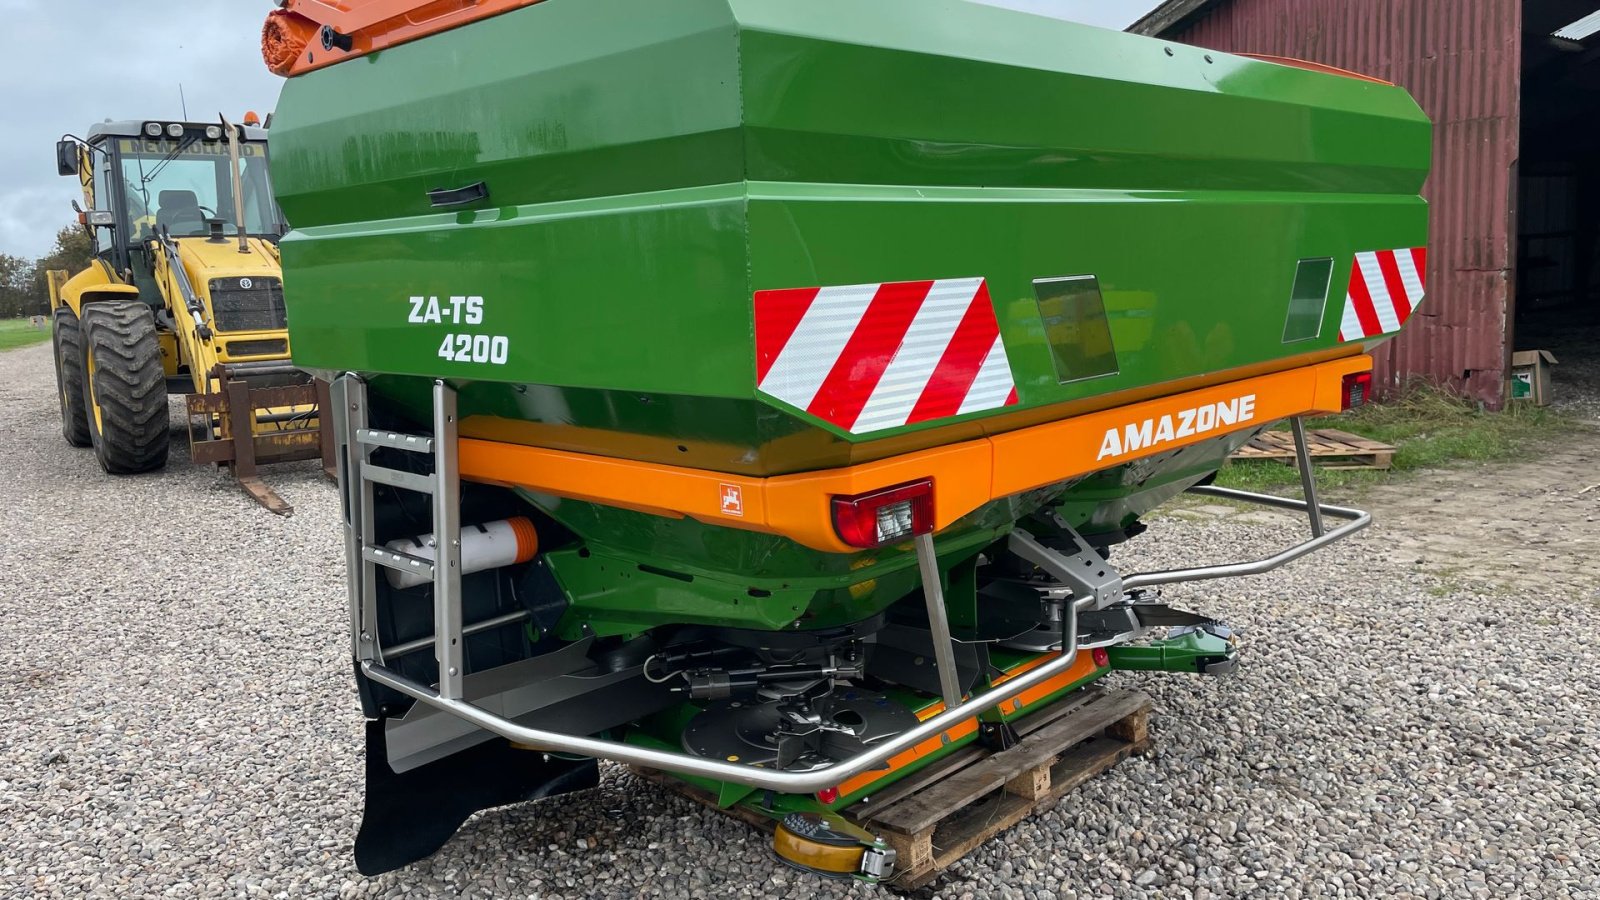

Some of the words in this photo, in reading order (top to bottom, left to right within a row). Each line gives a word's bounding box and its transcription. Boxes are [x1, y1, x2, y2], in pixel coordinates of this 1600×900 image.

[130, 139, 173, 154] NEW
[408, 296, 484, 325] ZA-TS
[438, 333, 509, 365] 4200
[1097, 394, 1256, 461] AMAZONE
